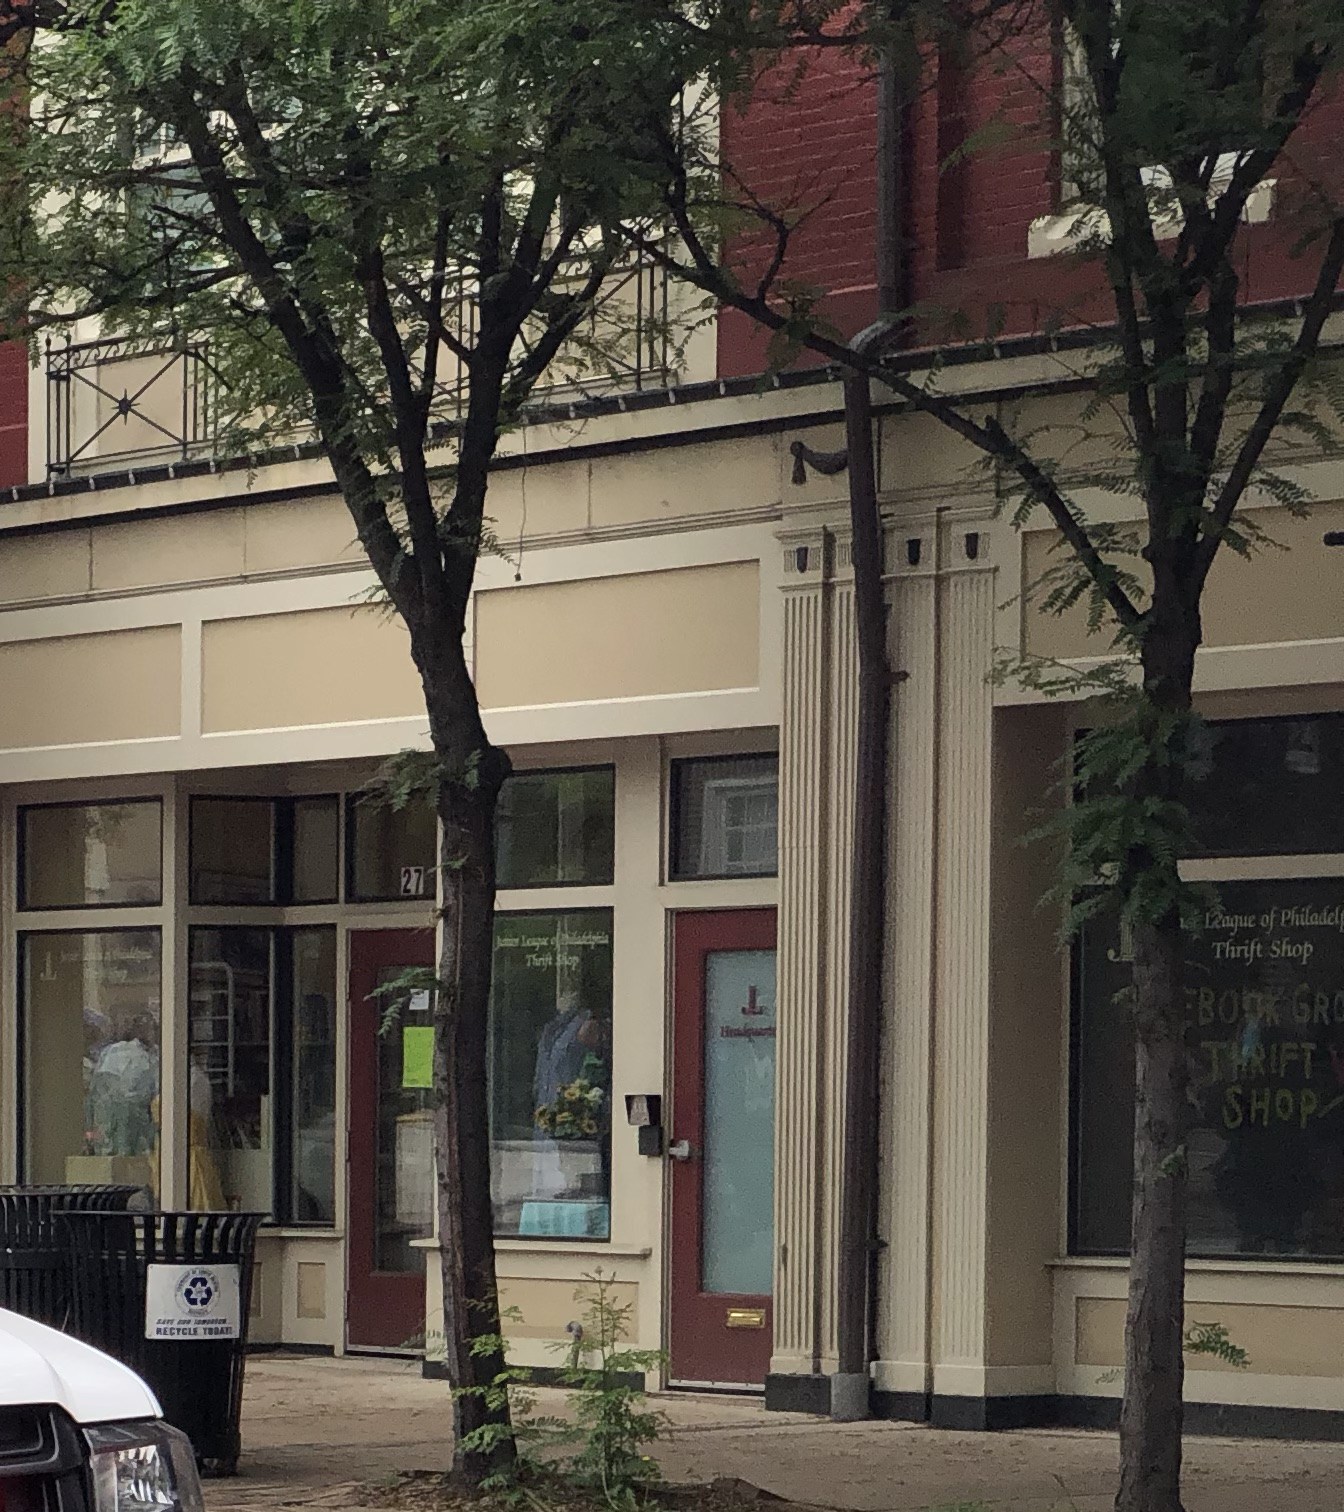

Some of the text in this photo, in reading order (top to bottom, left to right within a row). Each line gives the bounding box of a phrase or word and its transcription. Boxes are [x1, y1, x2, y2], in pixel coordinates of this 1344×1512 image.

[403, 869, 422, 894] 27
[1205, 911, 1256, 936] League
[1261, 907, 1278, 935] of
[1212, 937, 1313, 966] Thrift Shop
[1223, 1085, 1318, 1130] SHOP
[156, 1327, 197, 1336] RECYCLE
